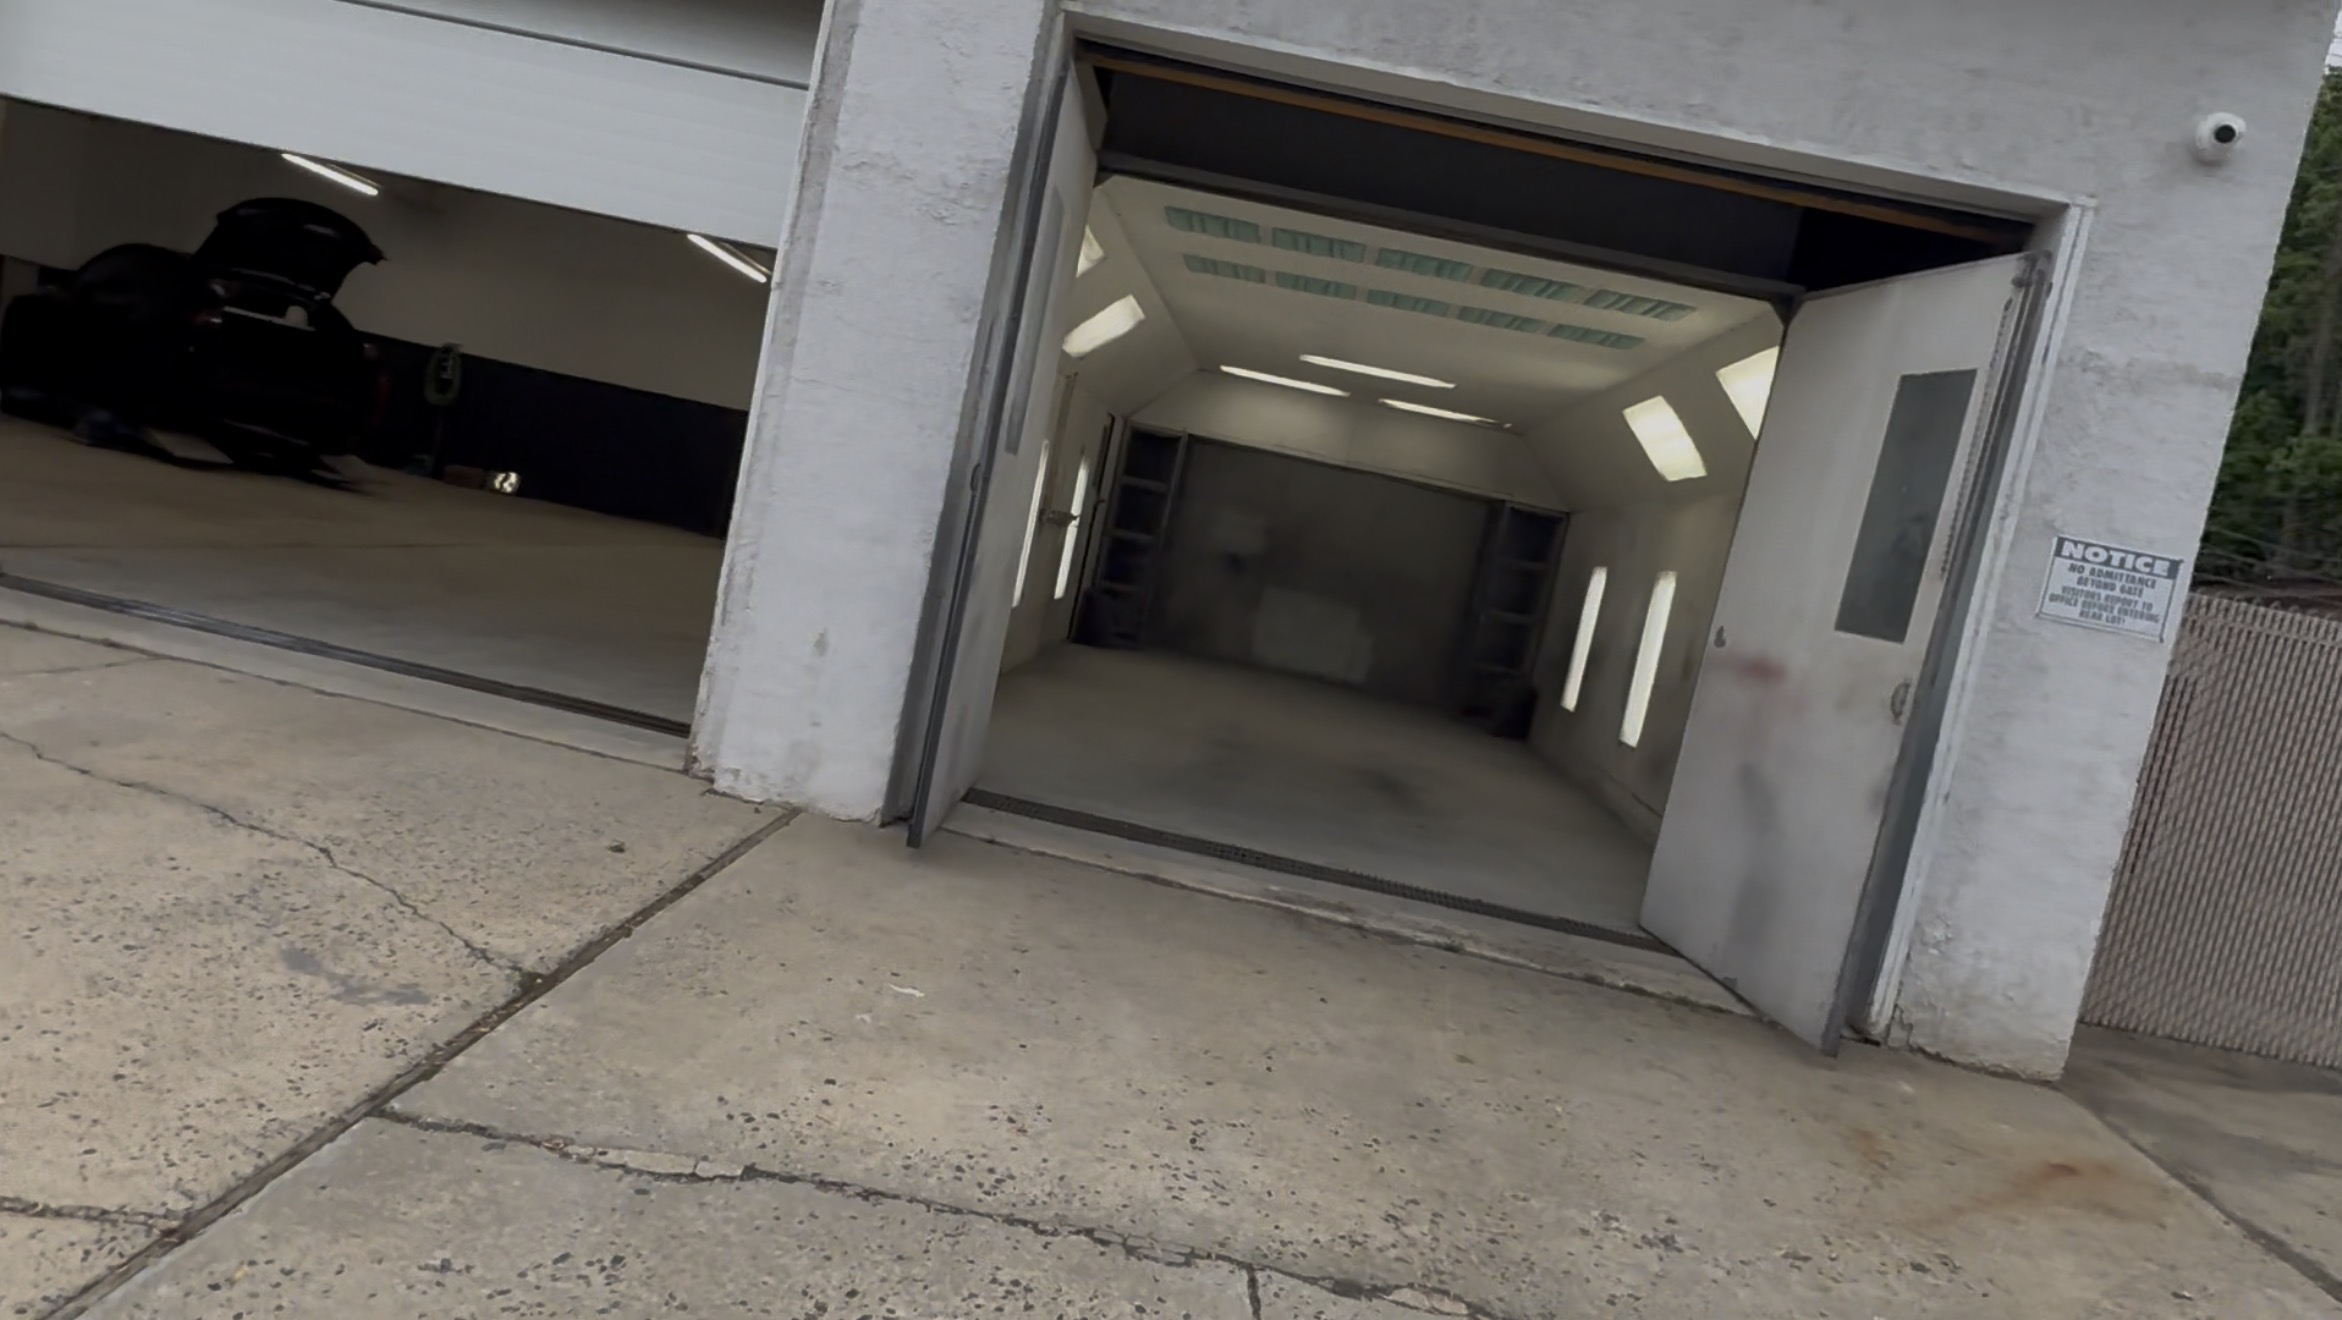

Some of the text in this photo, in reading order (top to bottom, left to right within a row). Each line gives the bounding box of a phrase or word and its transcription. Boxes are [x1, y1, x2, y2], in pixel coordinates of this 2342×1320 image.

[2061, 541, 2169, 576] NOTICE
[2069, 563, 2156, 589] NO ADMITTANCE
[2077, 576, 2143, 597] BEYOND GATE
